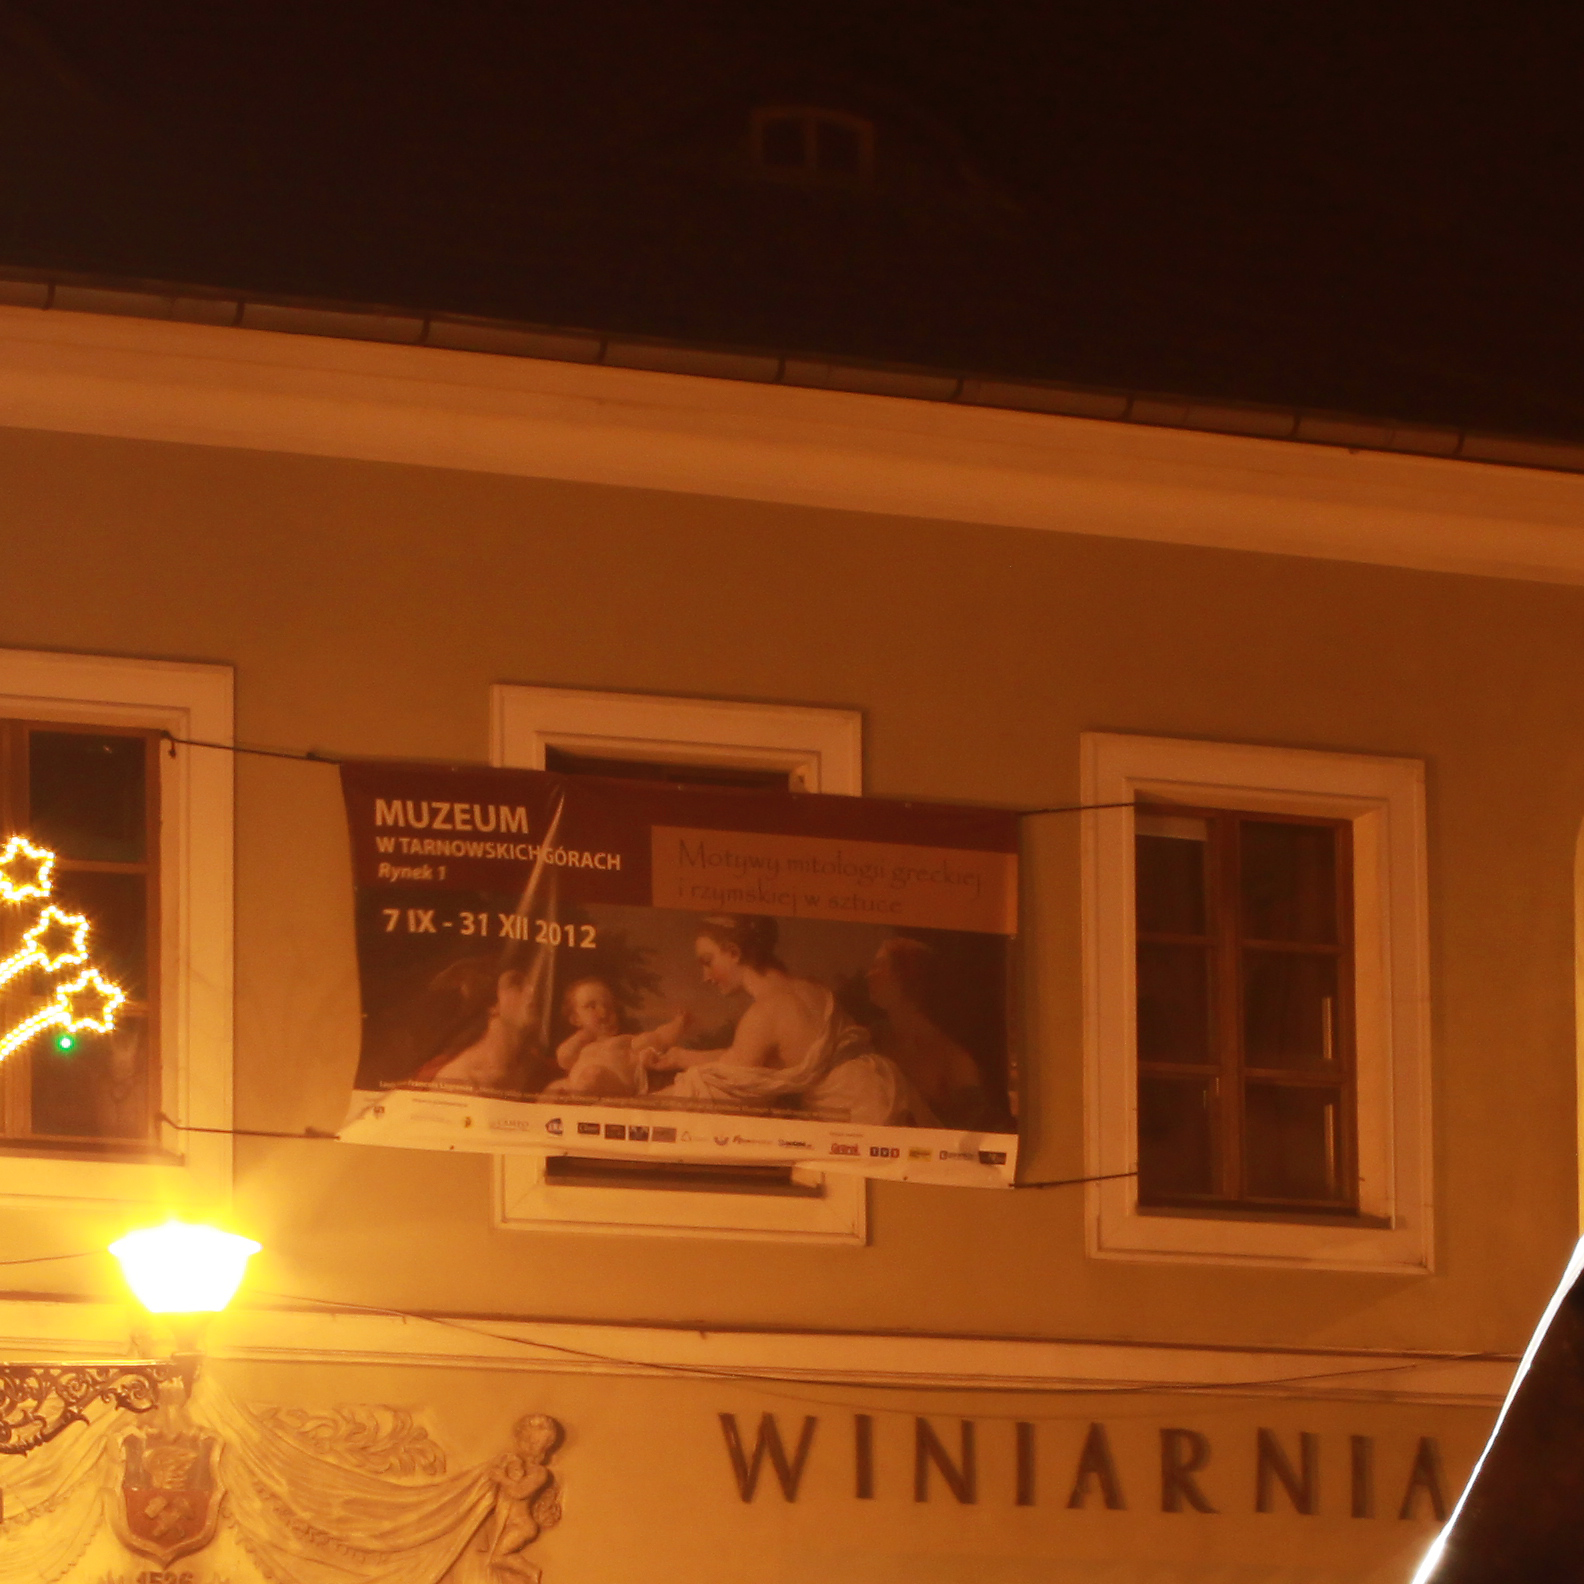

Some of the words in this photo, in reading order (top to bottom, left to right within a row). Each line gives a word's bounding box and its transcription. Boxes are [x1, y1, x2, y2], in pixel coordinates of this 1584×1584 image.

[374, 799, 529, 834] MUZEUM
[376, 836, 395, 854] W
[399, 838, 538, 862] TARNOWSKICH
[543, 847, 621, 871] GÓRACH
[378, 861, 433, 882] Rynek
[438, 865, 447, 880] 1
[677, 839, 780, 877] Motywy
[786, 850, 885, 887] mitologii
[891, 858, 983, 898] greckiej
[690, 878, 798, 914] rzymskiej
[828, 892, 903, 914] sztuce
[382, 908, 401, 932] 7
[407, 909, 437, 934] IX
[459, 912, 489, 937] 31
[498, 913, 529, 941] XII
[535, 919, 597, 948] 2012
[717, 1411, 1452, 1522] WINIARNIA
